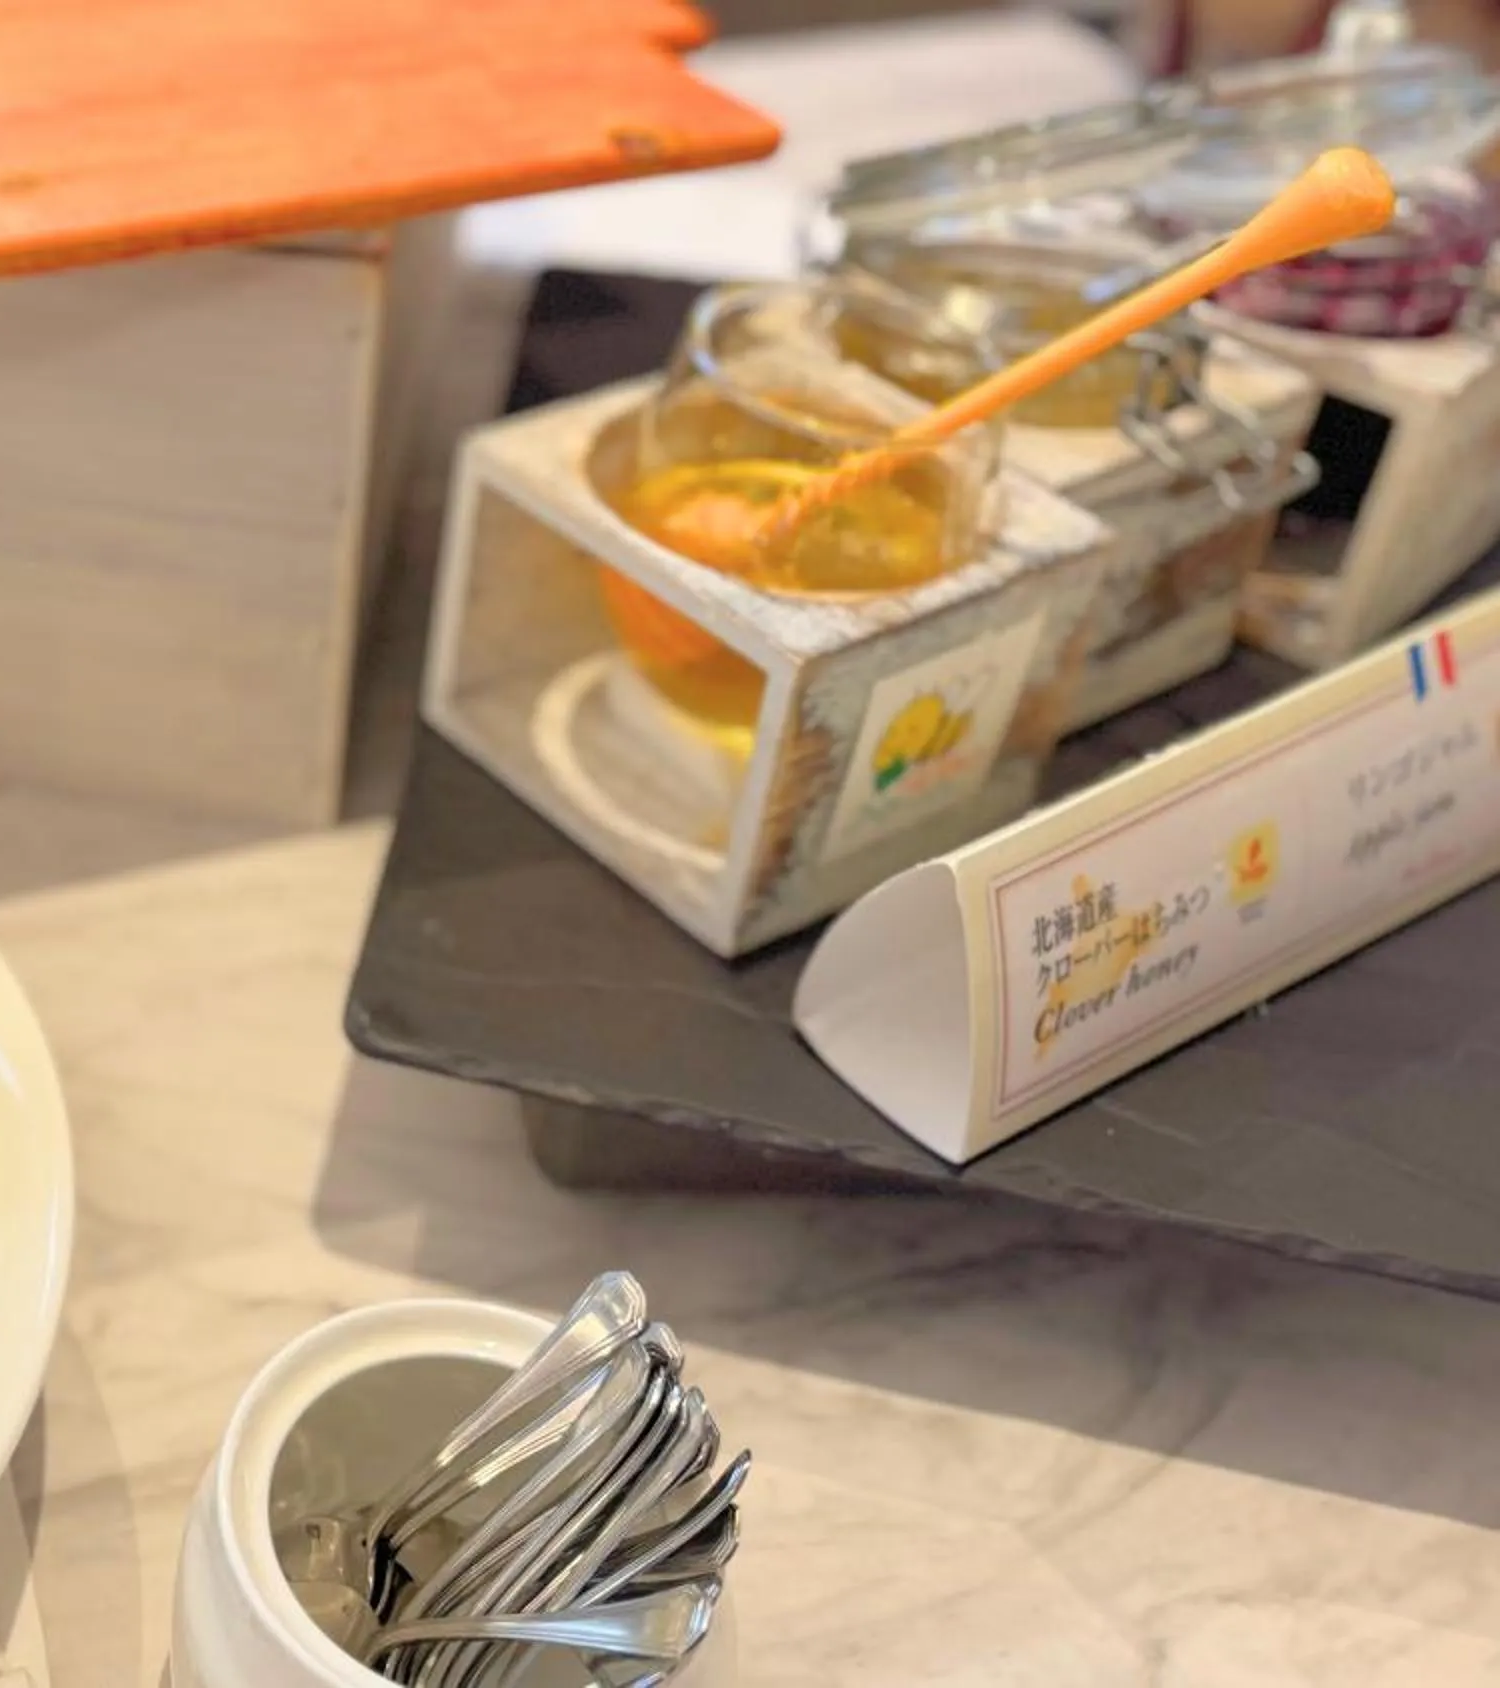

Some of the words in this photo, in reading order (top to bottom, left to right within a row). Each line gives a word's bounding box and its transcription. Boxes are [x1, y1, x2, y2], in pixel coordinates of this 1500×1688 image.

[1032, 881, 1117, 955] 北海道産
[1036, 885, 1210, 998] クローバーはちみつ
[1033, 986, 1117, 1044] Clover
[1124, 942, 1198, 998] honey
